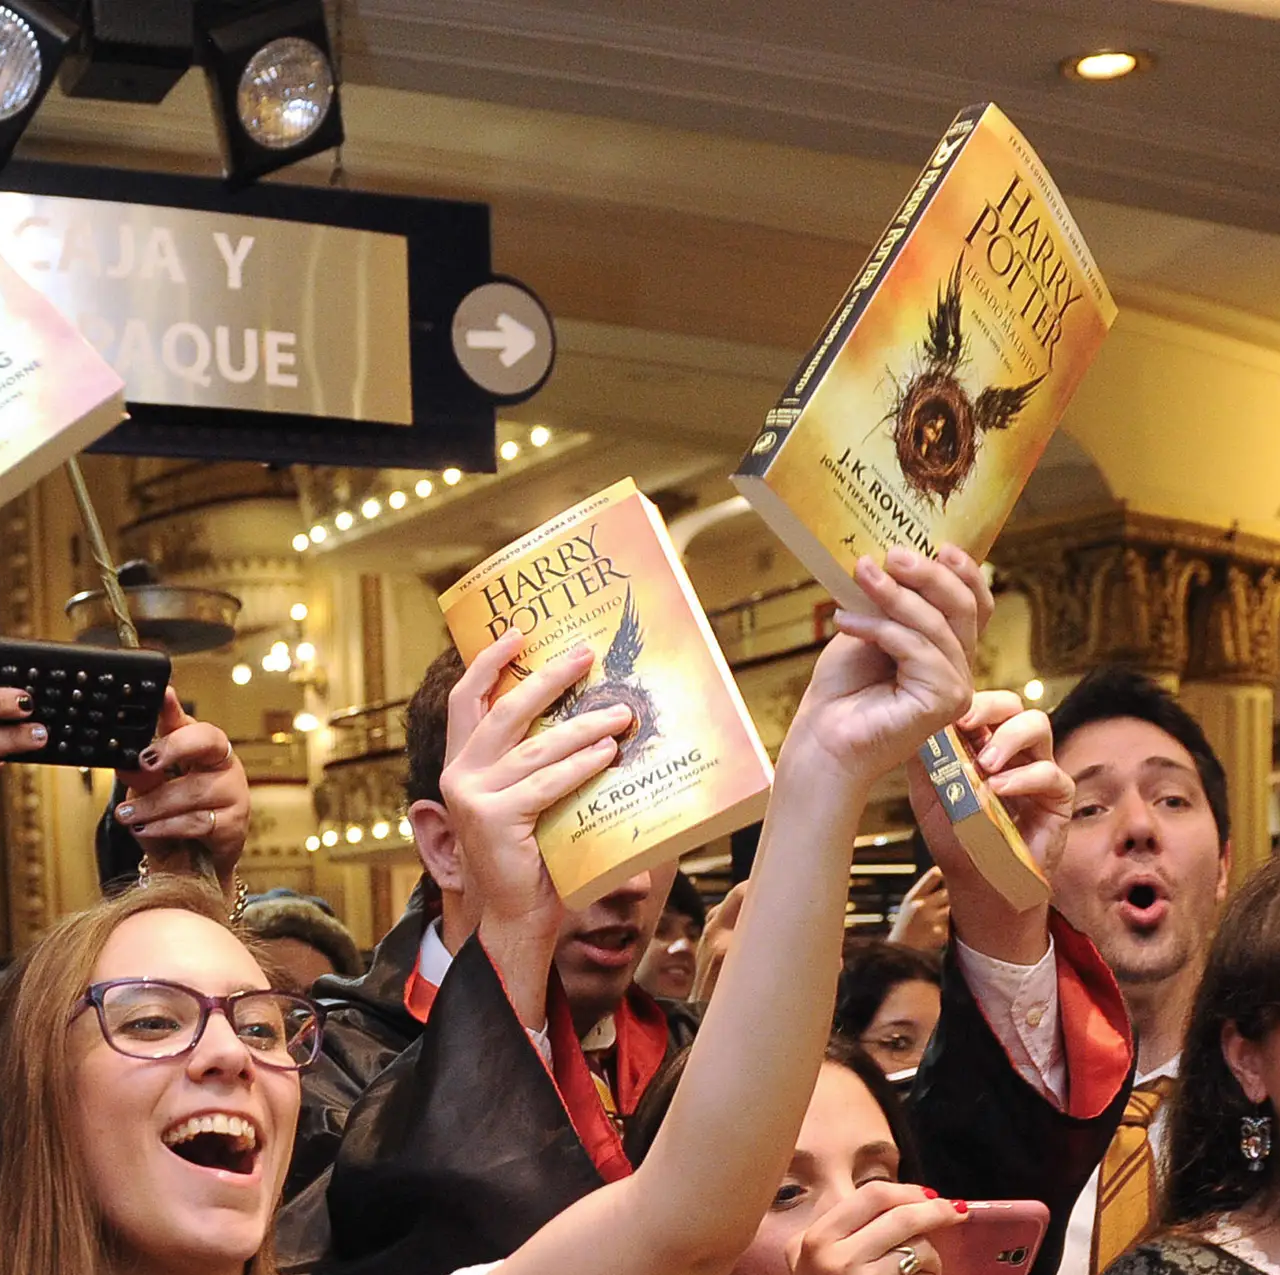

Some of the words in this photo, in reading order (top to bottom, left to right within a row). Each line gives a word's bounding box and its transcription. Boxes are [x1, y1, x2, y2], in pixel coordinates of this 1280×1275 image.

[15, 215, 187, 284] CAJA
[214, 232, 256, 289] Y
[997, 171, 1084, 319] HARRY
[965, 199, 1062, 372] POTTER
[965, 263, 1004, 319] LEGADO
[77, 321, 299, 388] PAQUE
[820, 453, 846, 485] JOHN
[847, 481, 882, 524] TIFFANY
[458, 572, 482, 592] TEXTO
[482, 547, 521, 575] COMPLETO
[579, 497, 610, 516] TEATRO
[481, 522, 601, 618] HARRY
[485, 556, 632, 642] POTTER
[566, 595, 623, 634] MALDITO
[570, 822, 597, 844] JOHN
[598, 799, 641, 823] TIFFANY
[576, 799, 608, 826] J.K.
[609, 748, 702, 805] ROWLING
